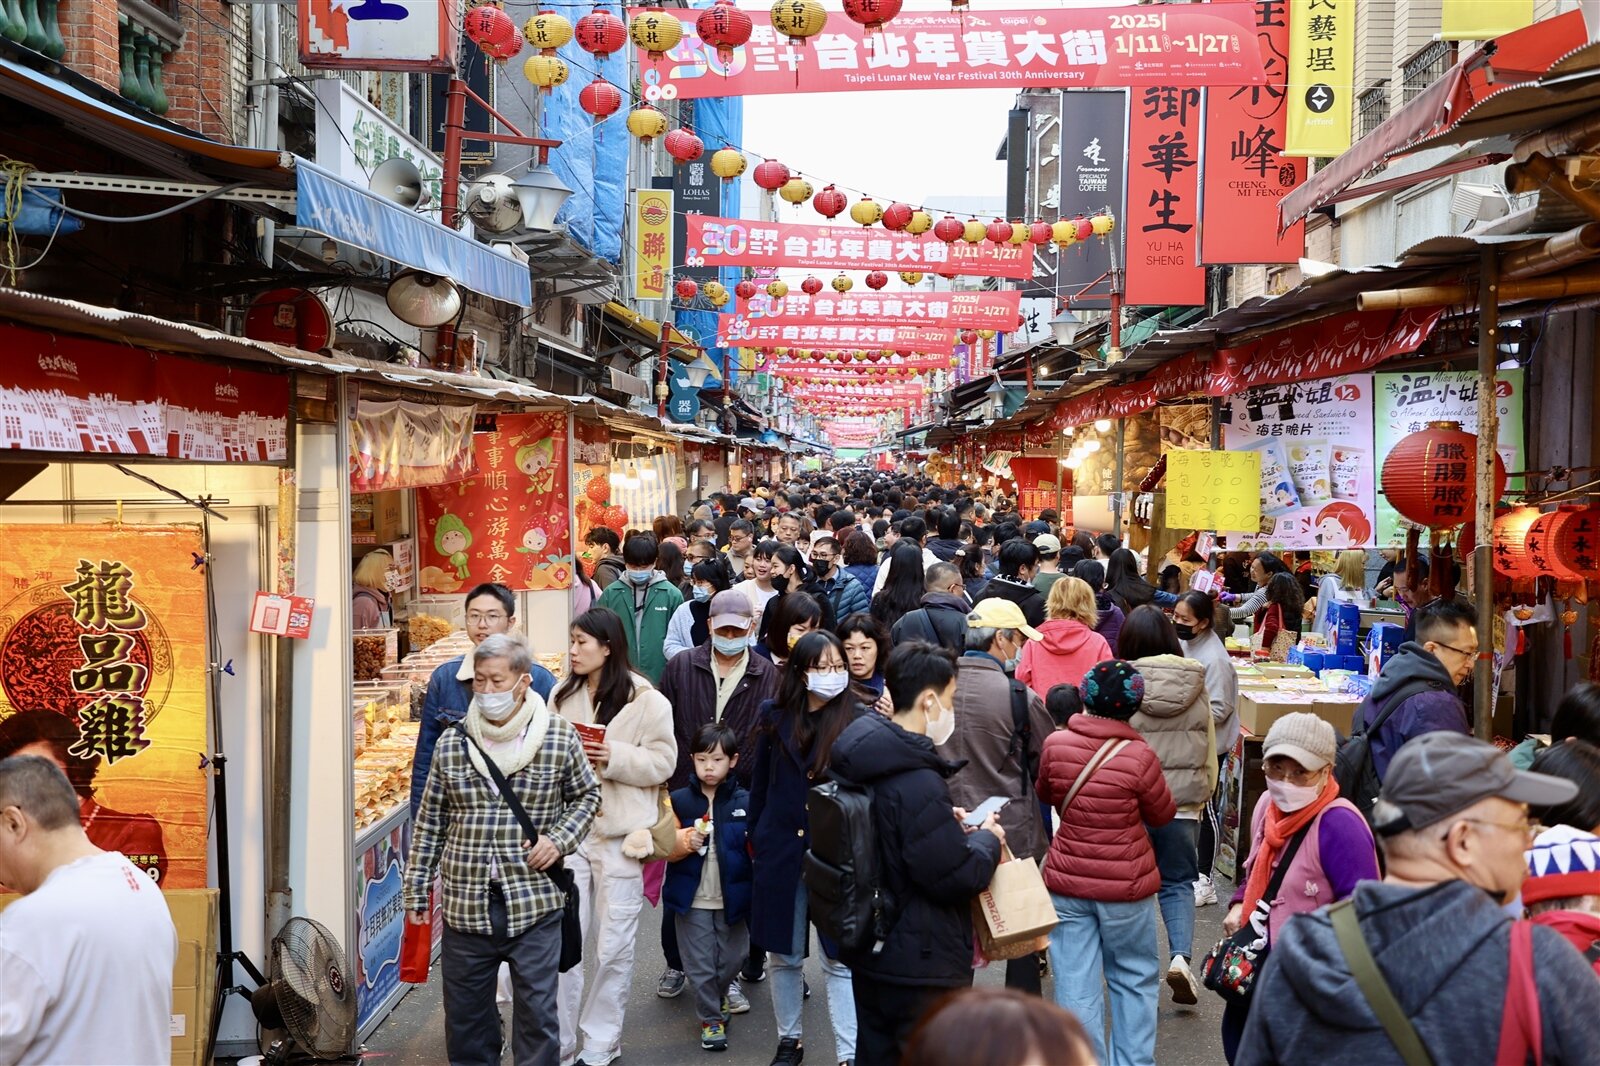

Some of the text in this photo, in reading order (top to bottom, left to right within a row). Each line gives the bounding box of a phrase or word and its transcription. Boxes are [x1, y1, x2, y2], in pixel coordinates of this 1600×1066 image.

[712, 7, 727, 34] 台北
[791, 1, 805, 29] 台北
[535, 19, 549, 42] 台北
[593, 17, 606, 44] 台北
[646, 18, 660, 43] 台北
[812, 29, 1108, 69] 台北年貨大街
[1114, 34, 1162, 57] 1/11
[844, 70, 1085, 83] Taipei Lunar New Year Festival 30th Anniversary
[1143, 87, 1200, 233] 御華生
[683, 188, 710, 196] LOHAS
[1229, 180, 1267, 189] CHENG
[1238, 188, 1285, 197] MI FENG
[784, 236, 948, 263] 台北年貨大街
[952, 246, 979, 260] 1/11
[1146, 241, 1184, 252] YU HA
[642, 232, 666, 294] 聯通
[1146, 255, 1184, 265] SHENG
[952, 295, 980, 304] 2025/
[814, 299, 949, 318] 台北年貨大街
[952, 305, 973, 317] 1/11
[782, 326, 895, 342] 台北年貨大街
[1432, 371, 1474, 383] Miss Wen
[1397, 375, 1479, 407] 溫小姐
[1313, 408, 1348, 419] Sandwich
[1256, 423, 1314, 437] 海苔脆片
[1202, 474, 1242, 488] 100
[1199, 496, 1240, 505] 200
[62, 560, 152, 766] 龍品雞
